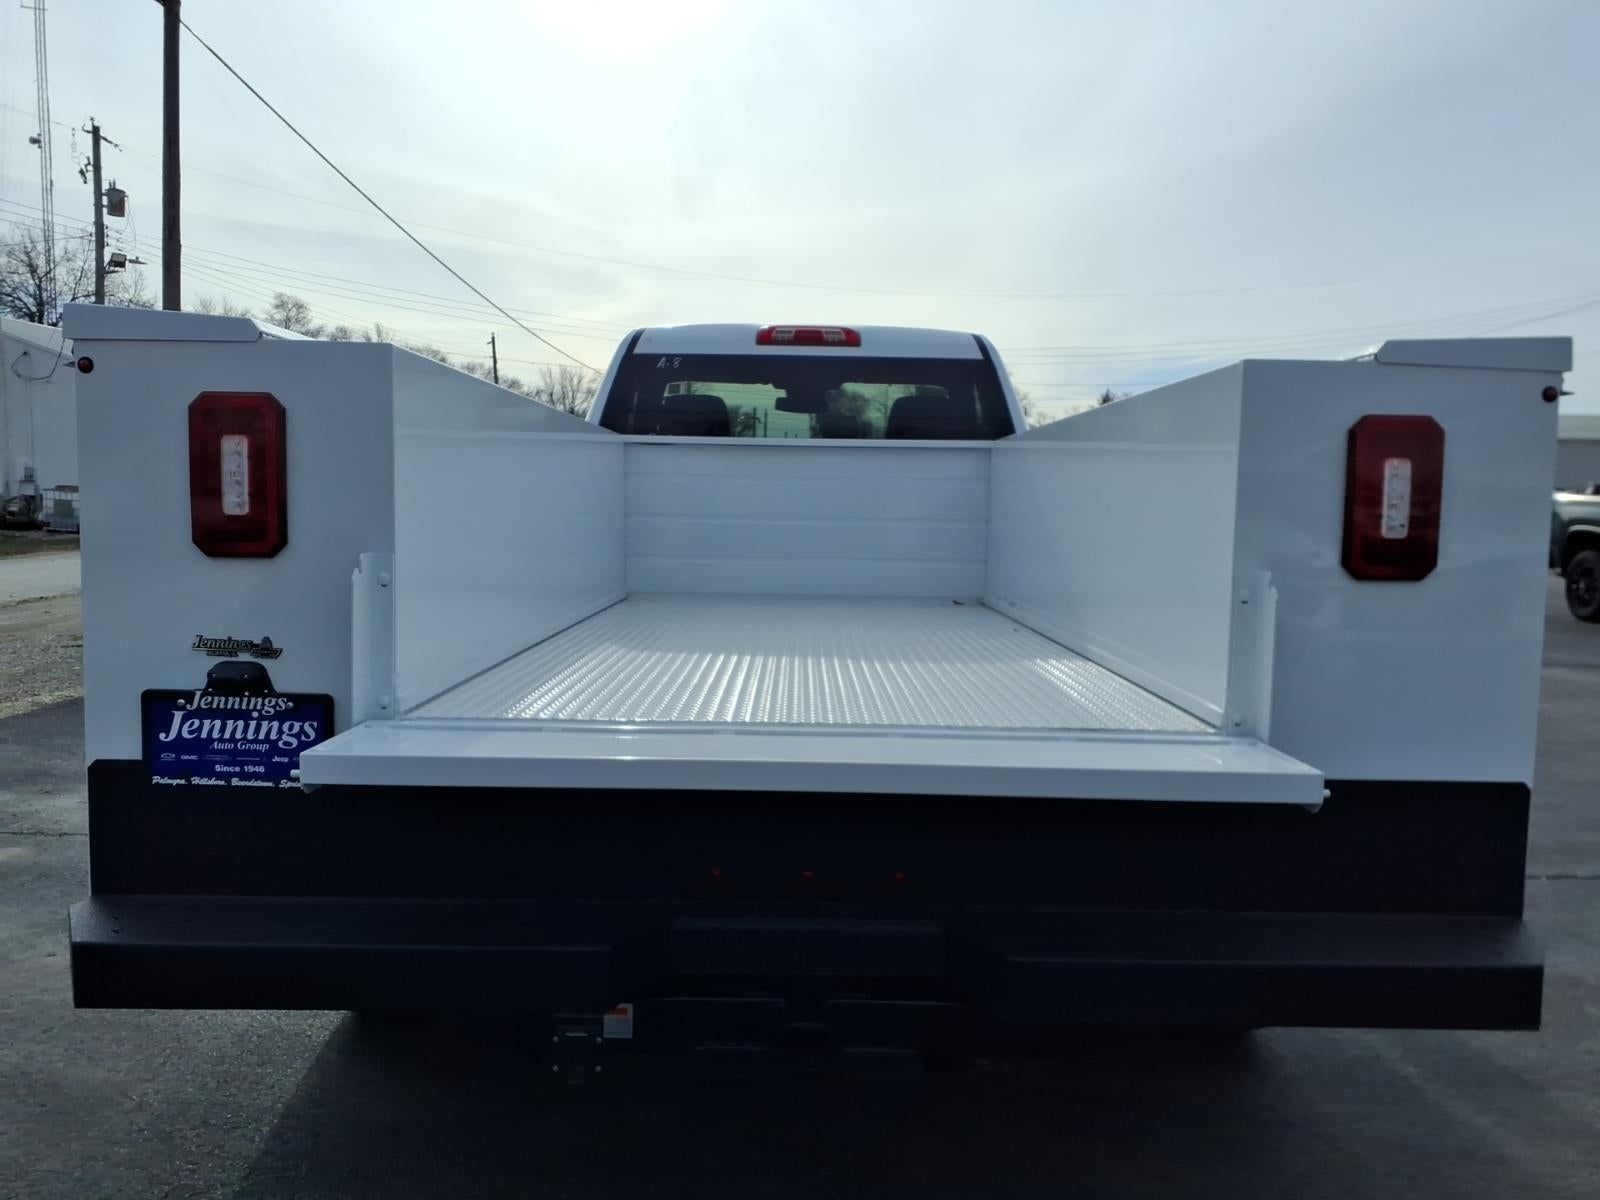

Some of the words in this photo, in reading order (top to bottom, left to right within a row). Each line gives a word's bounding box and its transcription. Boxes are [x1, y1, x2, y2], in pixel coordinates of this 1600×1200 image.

[192, 634, 254, 649] Jennings
[186, 690, 287, 715] Jennings
[158, 711, 318, 749] Jennings
[210, 741, 234, 750] Auto
[237, 741, 269, 752] Group
[215, 764, 241, 773] Since
[244, 765, 265, 773] 1946
